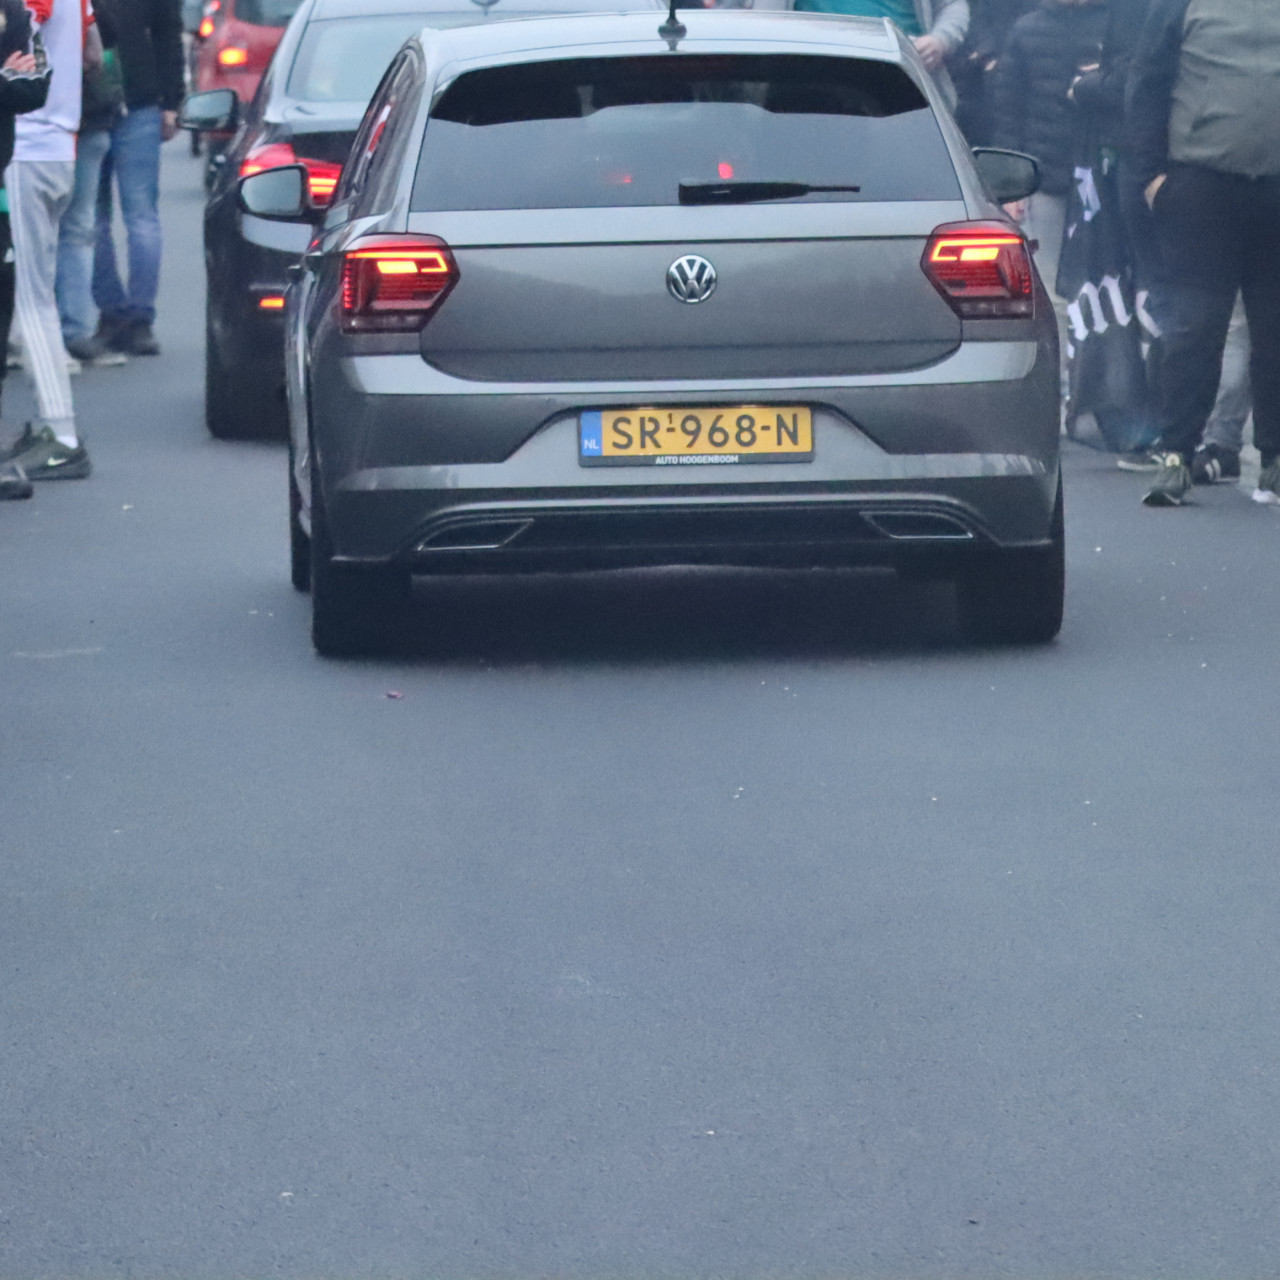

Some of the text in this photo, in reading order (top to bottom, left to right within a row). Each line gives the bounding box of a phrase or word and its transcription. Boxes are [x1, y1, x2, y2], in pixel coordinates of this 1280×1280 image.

[583, 413, 799, 450] NL SR-968-N
[655, 454, 739, 465] AUTO HOOGENBOOM
